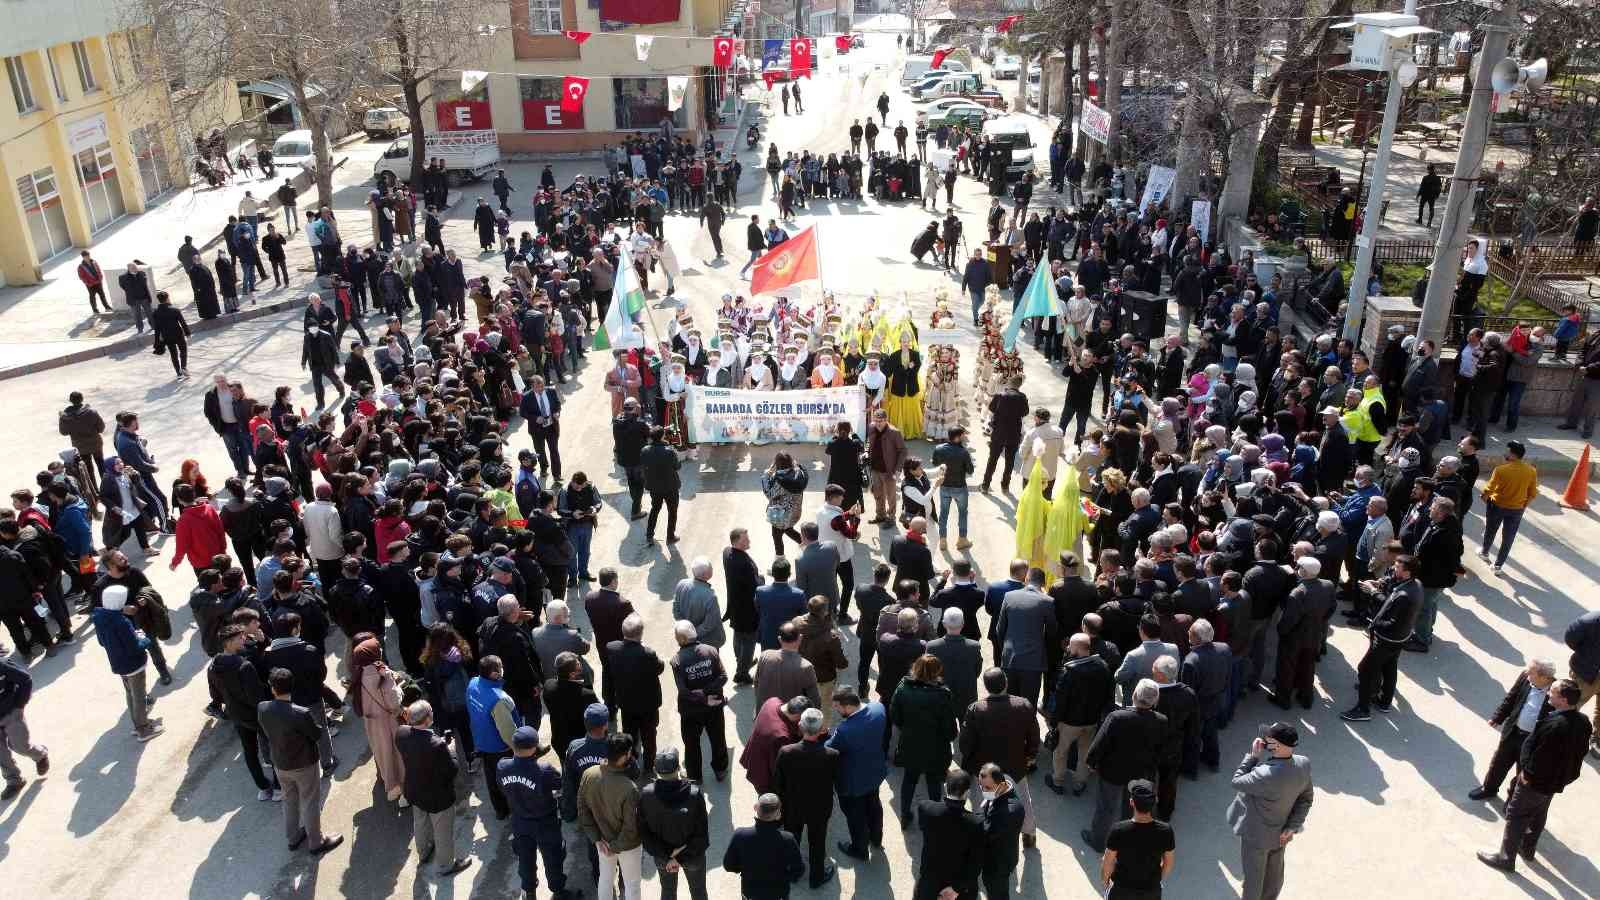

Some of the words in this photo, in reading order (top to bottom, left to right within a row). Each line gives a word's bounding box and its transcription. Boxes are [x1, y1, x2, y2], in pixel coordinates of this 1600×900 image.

[455, 107, 472, 126] E
[544, 105, 562, 125] E
[706, 403, 752, 414] BAHARDA
[756, 400, 792, 414] GÖZLER
[796, 403, 846, 414] BURSA'DA
[501, 775, 536, 790] JANDARMA
